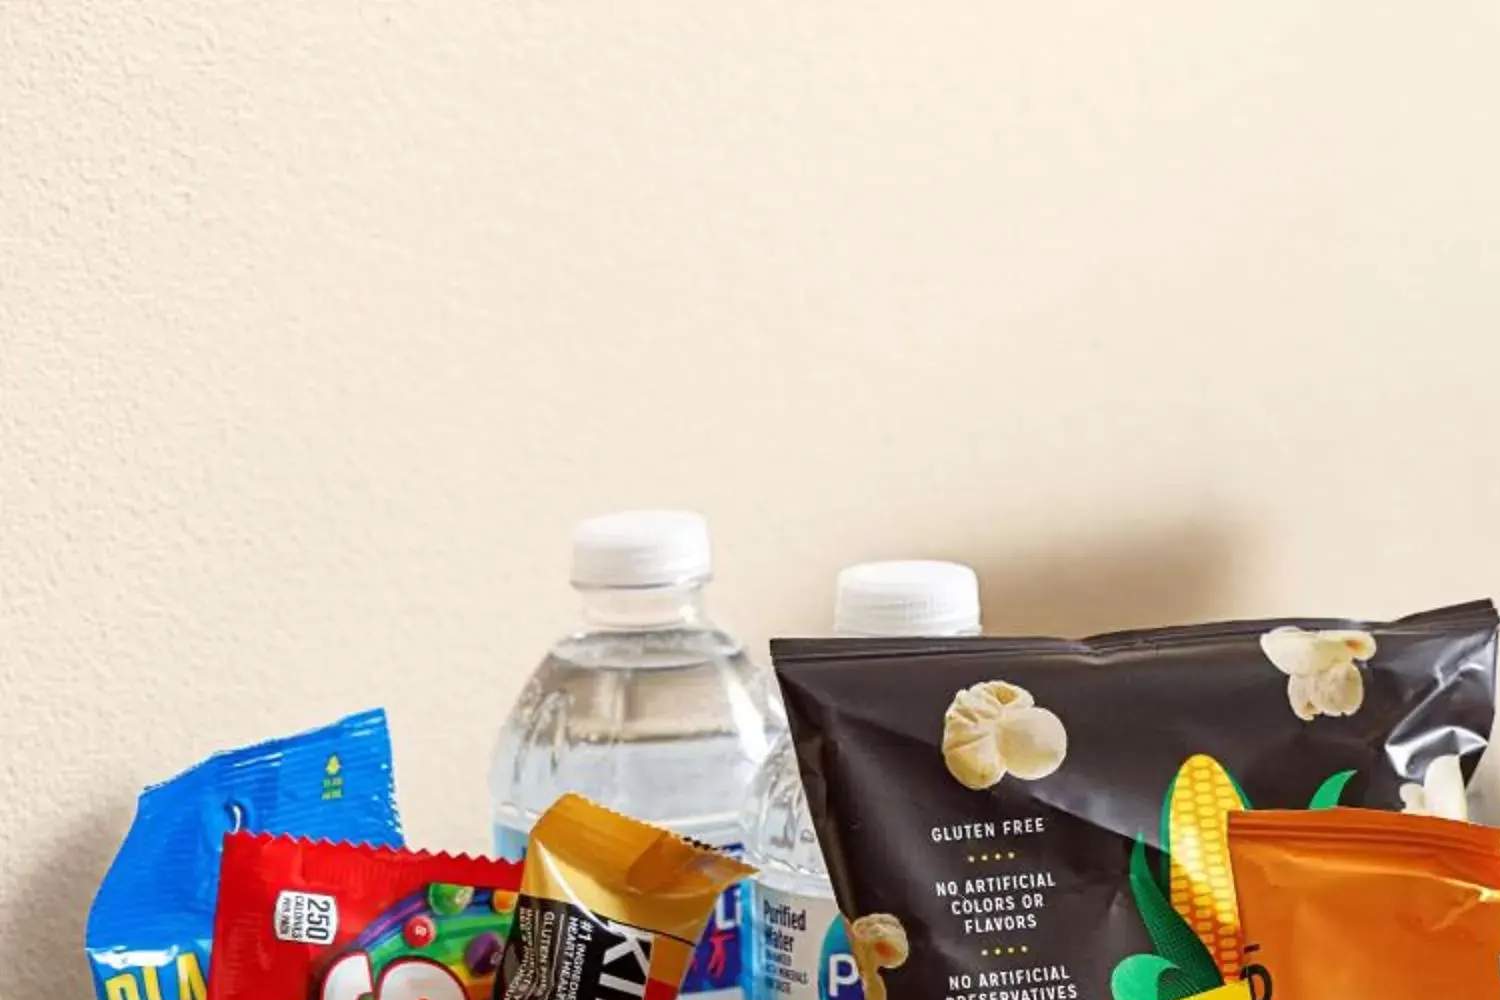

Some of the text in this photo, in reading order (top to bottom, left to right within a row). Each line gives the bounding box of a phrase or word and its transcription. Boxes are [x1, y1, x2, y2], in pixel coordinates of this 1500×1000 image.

[930, 817, 1046, 843] GLUTEN FREE
[935, 872, 1057, 897] NO ARTIFICIAL
[763, 901, 807, 932] Purified
[950, 893, 1045, 916] COLORS OR
[306, 899, 331, 940] 250
[579, 918, 594, 942] #1
[964, 914, 1038, 934] FLAVORS
[541, 912, 555, 961] GLUTEN
[948, 965, 1071, 991] NO ARTIFICIAL
